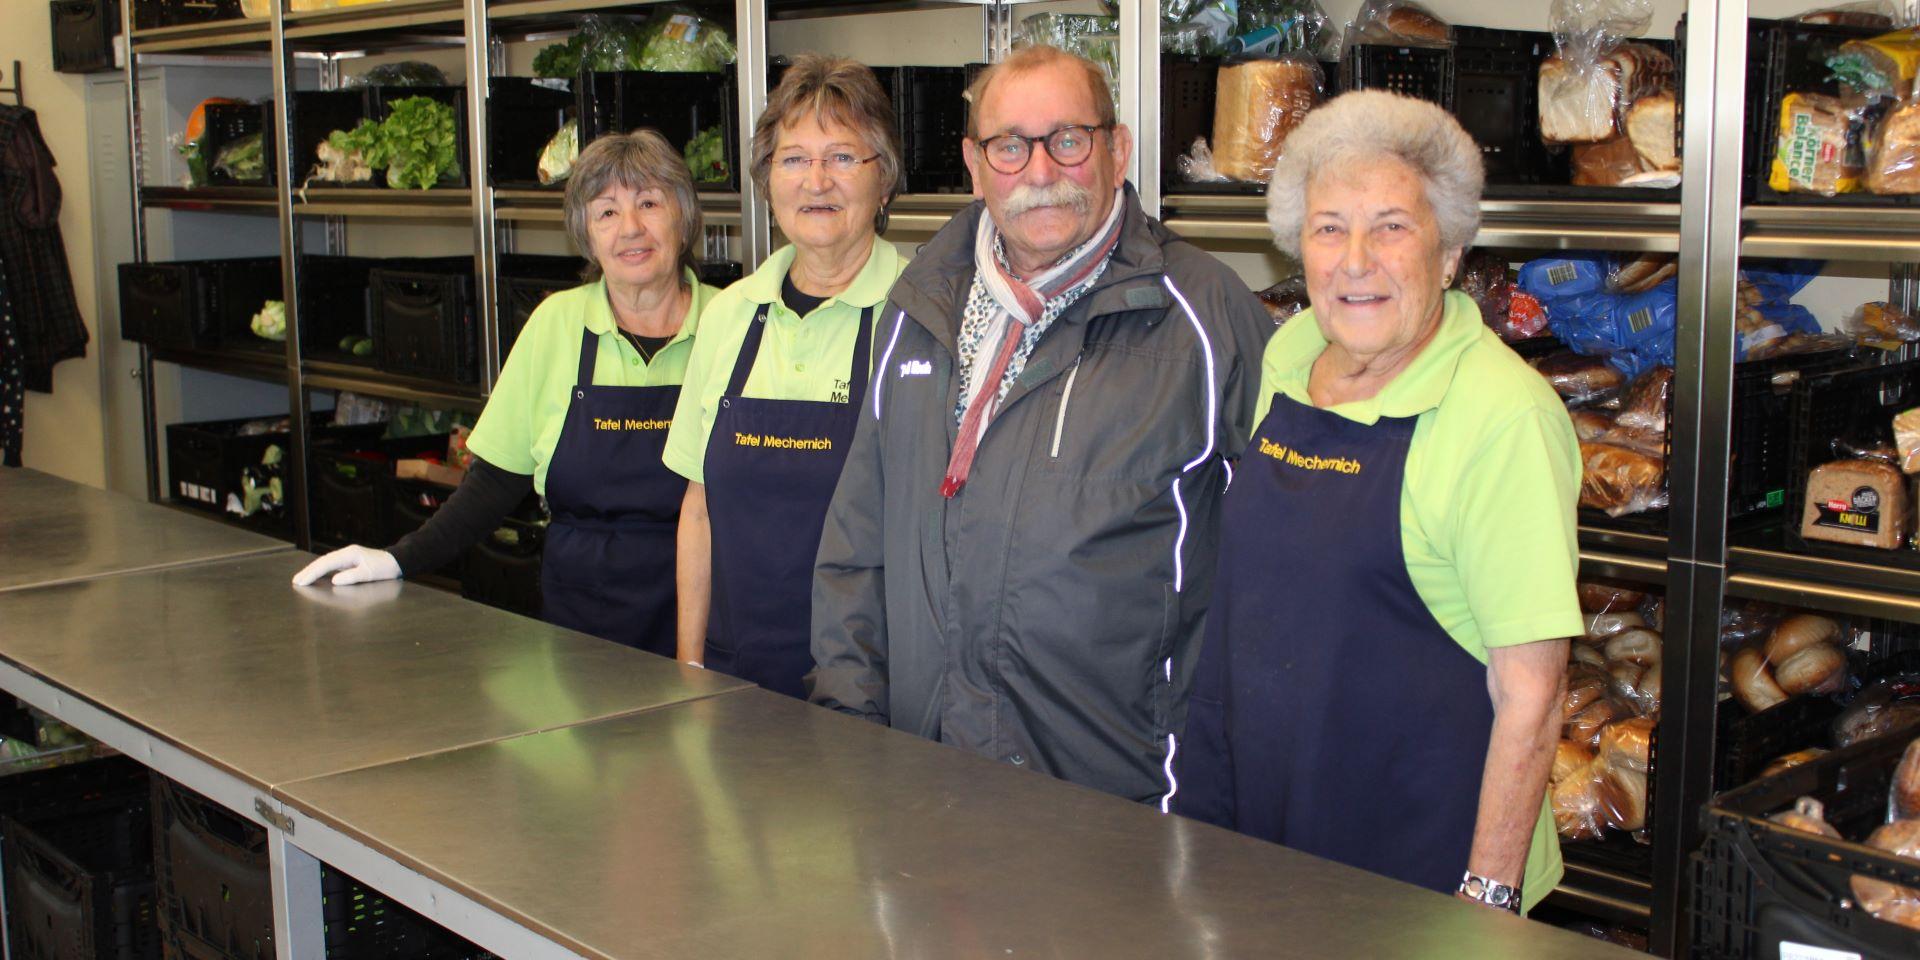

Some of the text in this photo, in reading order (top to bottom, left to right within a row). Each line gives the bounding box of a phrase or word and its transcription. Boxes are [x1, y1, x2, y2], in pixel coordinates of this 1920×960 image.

[1790, 114, 1809, 176] Balance
[594, 418, 621, 431] Tafel
[735, 432, 832, 450] Tafel Mechernich
[1259, 438, 1361, 474] Tafel Mechernich
